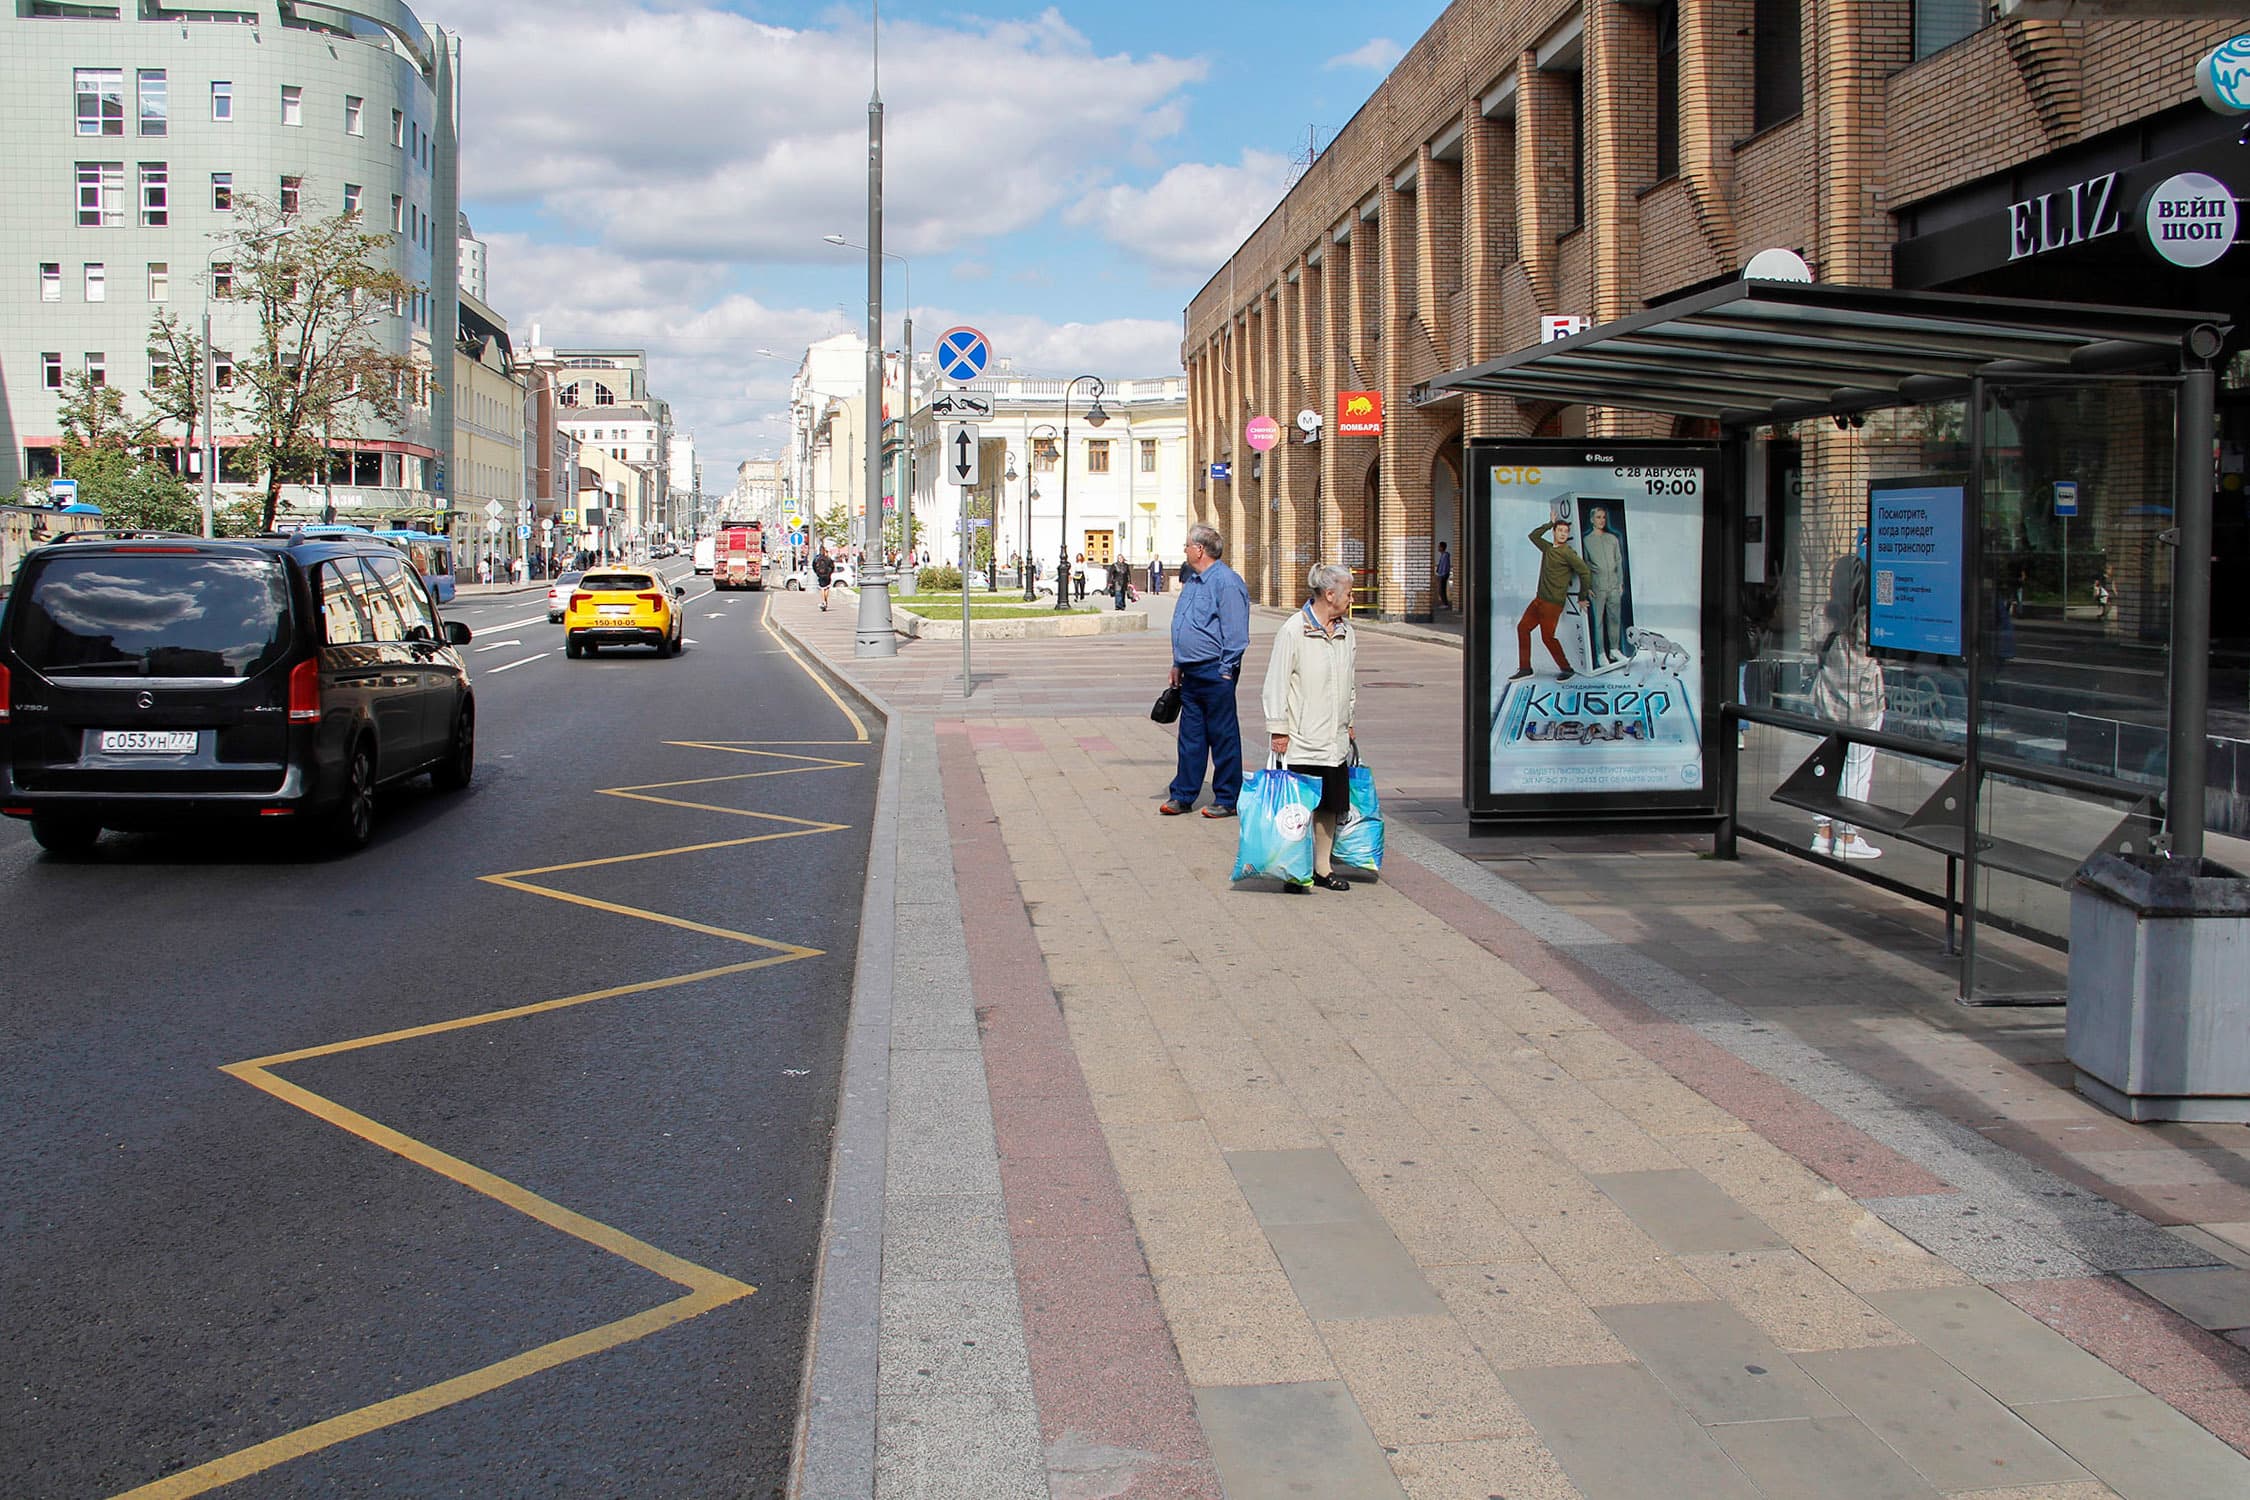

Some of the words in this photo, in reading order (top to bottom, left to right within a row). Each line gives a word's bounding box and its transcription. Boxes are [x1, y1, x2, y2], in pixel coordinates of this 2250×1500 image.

[2157, 196, 2226, 218] ВЕЙП
[2007, 171, 2120, 262] ELIZ
[2161, 222, 2223, 240] ШОП
[1339, 424, 1381, 433] ЛОМБАРД
[1594, 454, 1614, 462] Russ
[1495, 466, 1541, 485] СТС
[1614, 467, 1624, 477] С
[1627, 467, 1641, 477] 28
[1645, 467, 1697, 478] АВГУСТА
[1645, 479, 1697, 495] 19:00
[1878, 507, 1928, 521] Посмотрите,
[1878, 527, 1899, 538] когда
[1900, 526, 1934, 539] приедет
[1878, 543, 1893, 553] ваш
[1894, 543, 1936, 556] транспорт
